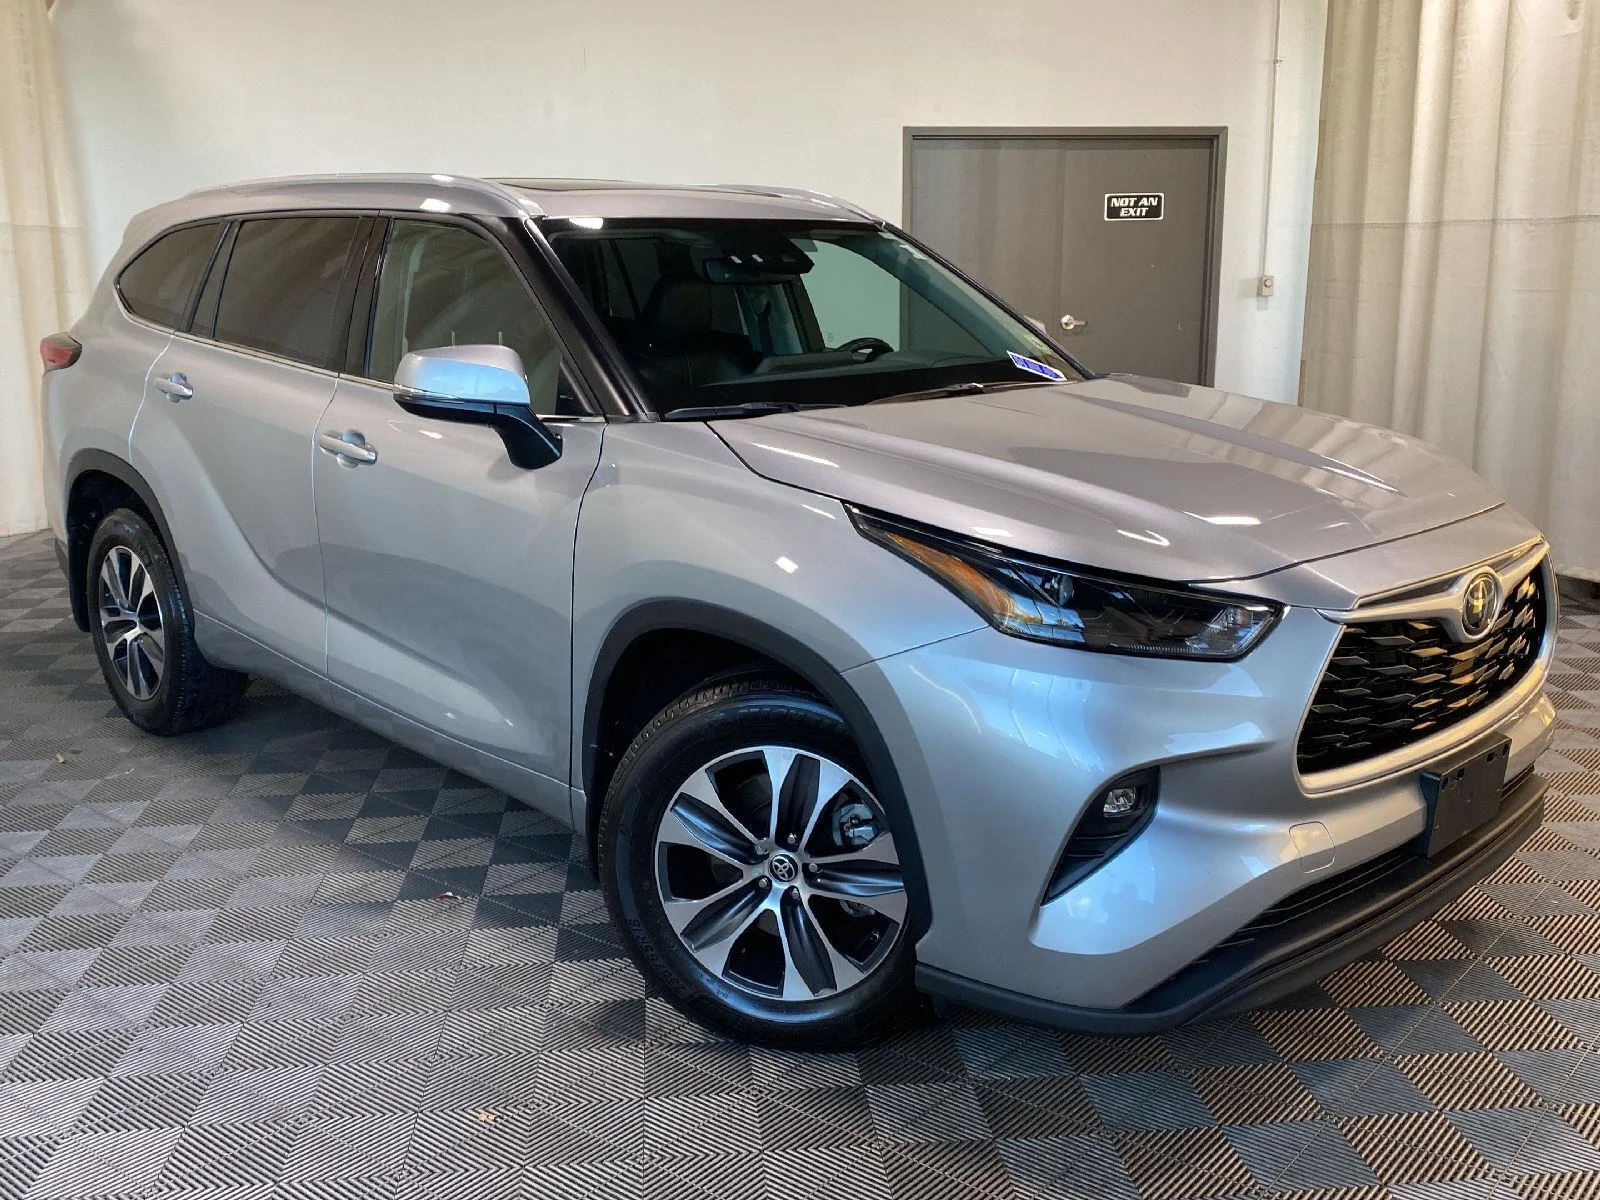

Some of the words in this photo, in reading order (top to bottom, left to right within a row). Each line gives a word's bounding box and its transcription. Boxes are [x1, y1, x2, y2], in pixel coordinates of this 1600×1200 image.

[1111, 197, 1137, 207] NOT
[1138, 197, 1158, 206] AN
[1120, 207, 1149, 217] EXIT
